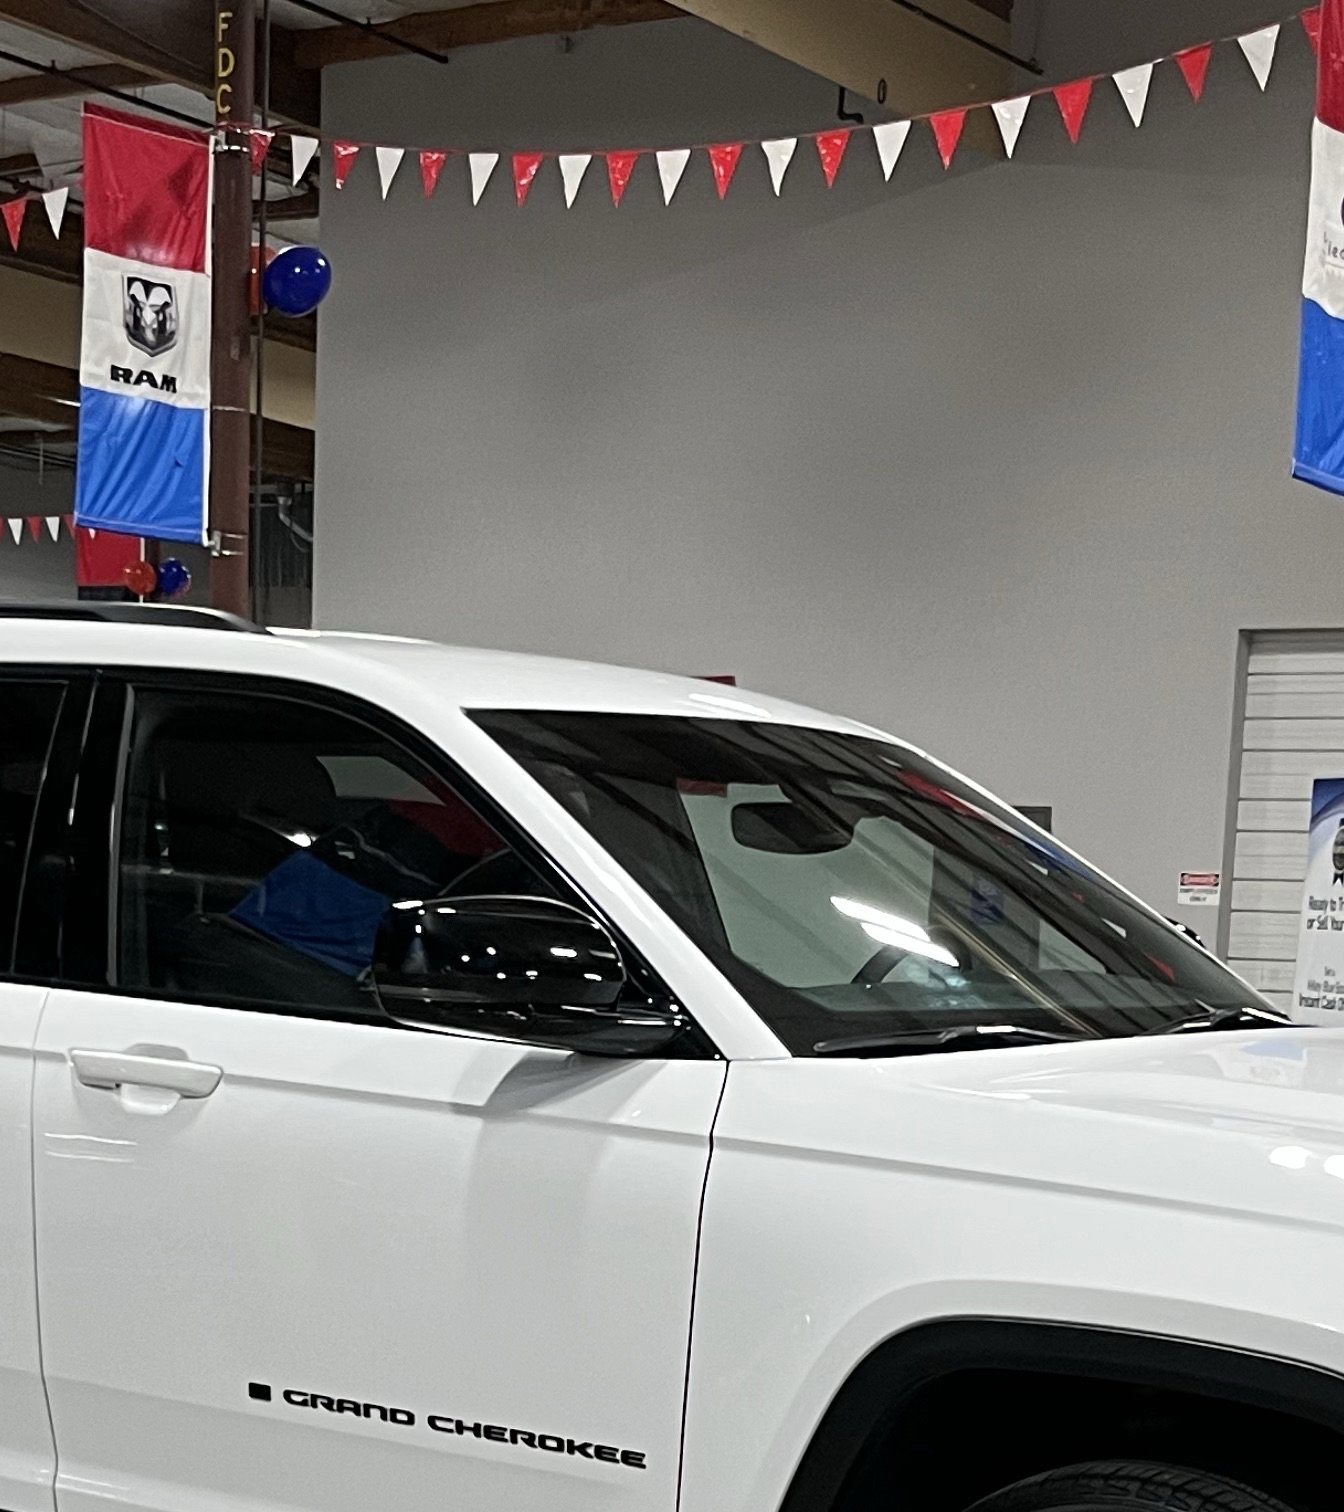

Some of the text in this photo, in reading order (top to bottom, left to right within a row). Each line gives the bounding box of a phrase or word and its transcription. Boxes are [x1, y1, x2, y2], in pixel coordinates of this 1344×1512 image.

[216, 11, 235, 114] FDC
[110, 363, 178, 394] RAM
[282, 1389, 647, 1470] GRAND CHEROKEE
